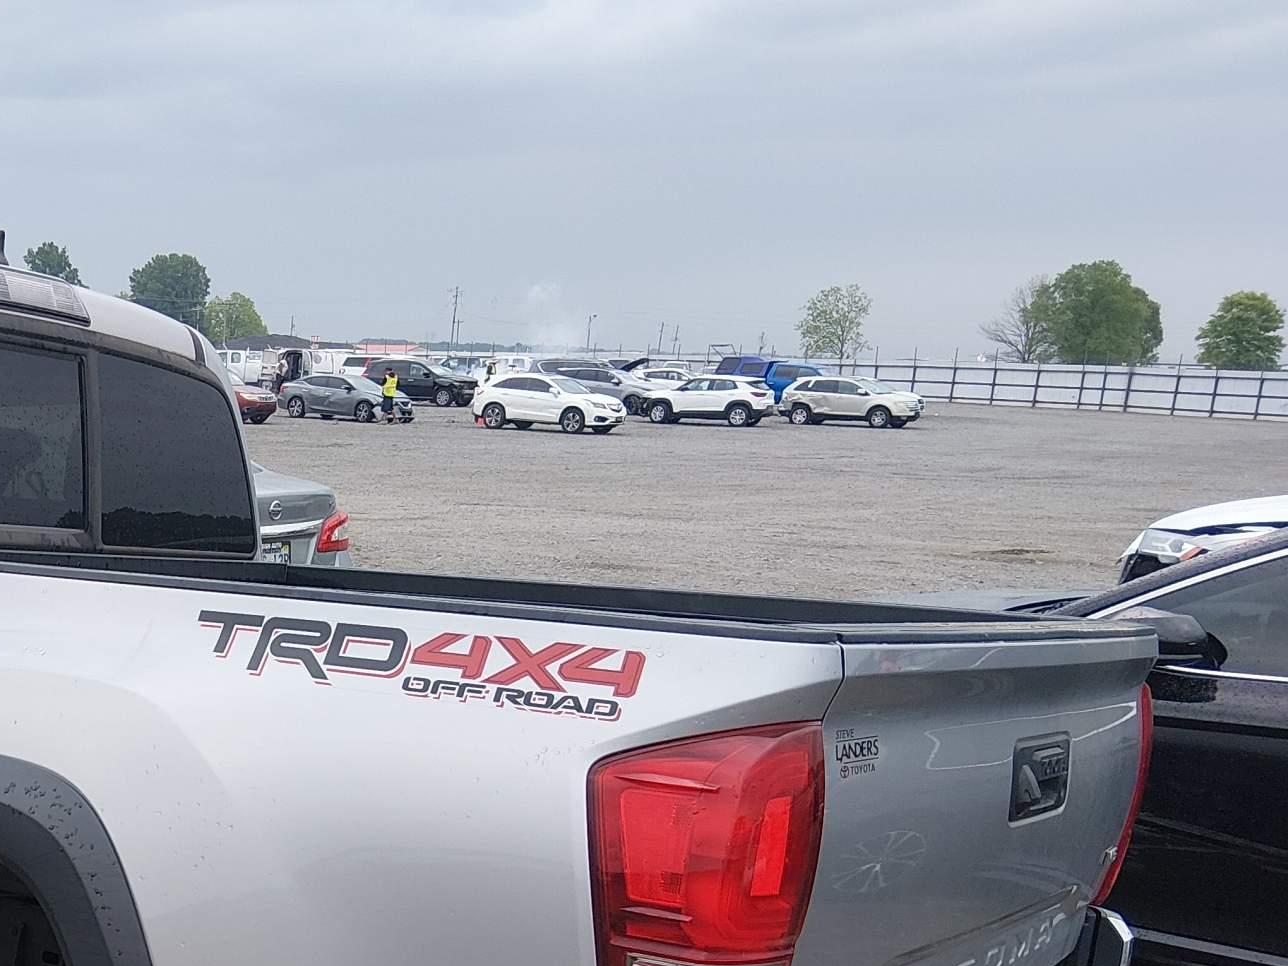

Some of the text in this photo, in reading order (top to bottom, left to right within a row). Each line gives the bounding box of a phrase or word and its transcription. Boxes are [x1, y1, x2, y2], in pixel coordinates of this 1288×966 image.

[197, 609, 410, 686] TRD
[400, 676, 621, 722] OFF ROAD
[835, 728, 855, 740] STEVE
[835, 738, 879, 763] LANDERS
[850, 763, 876, 776] TOYOTA
